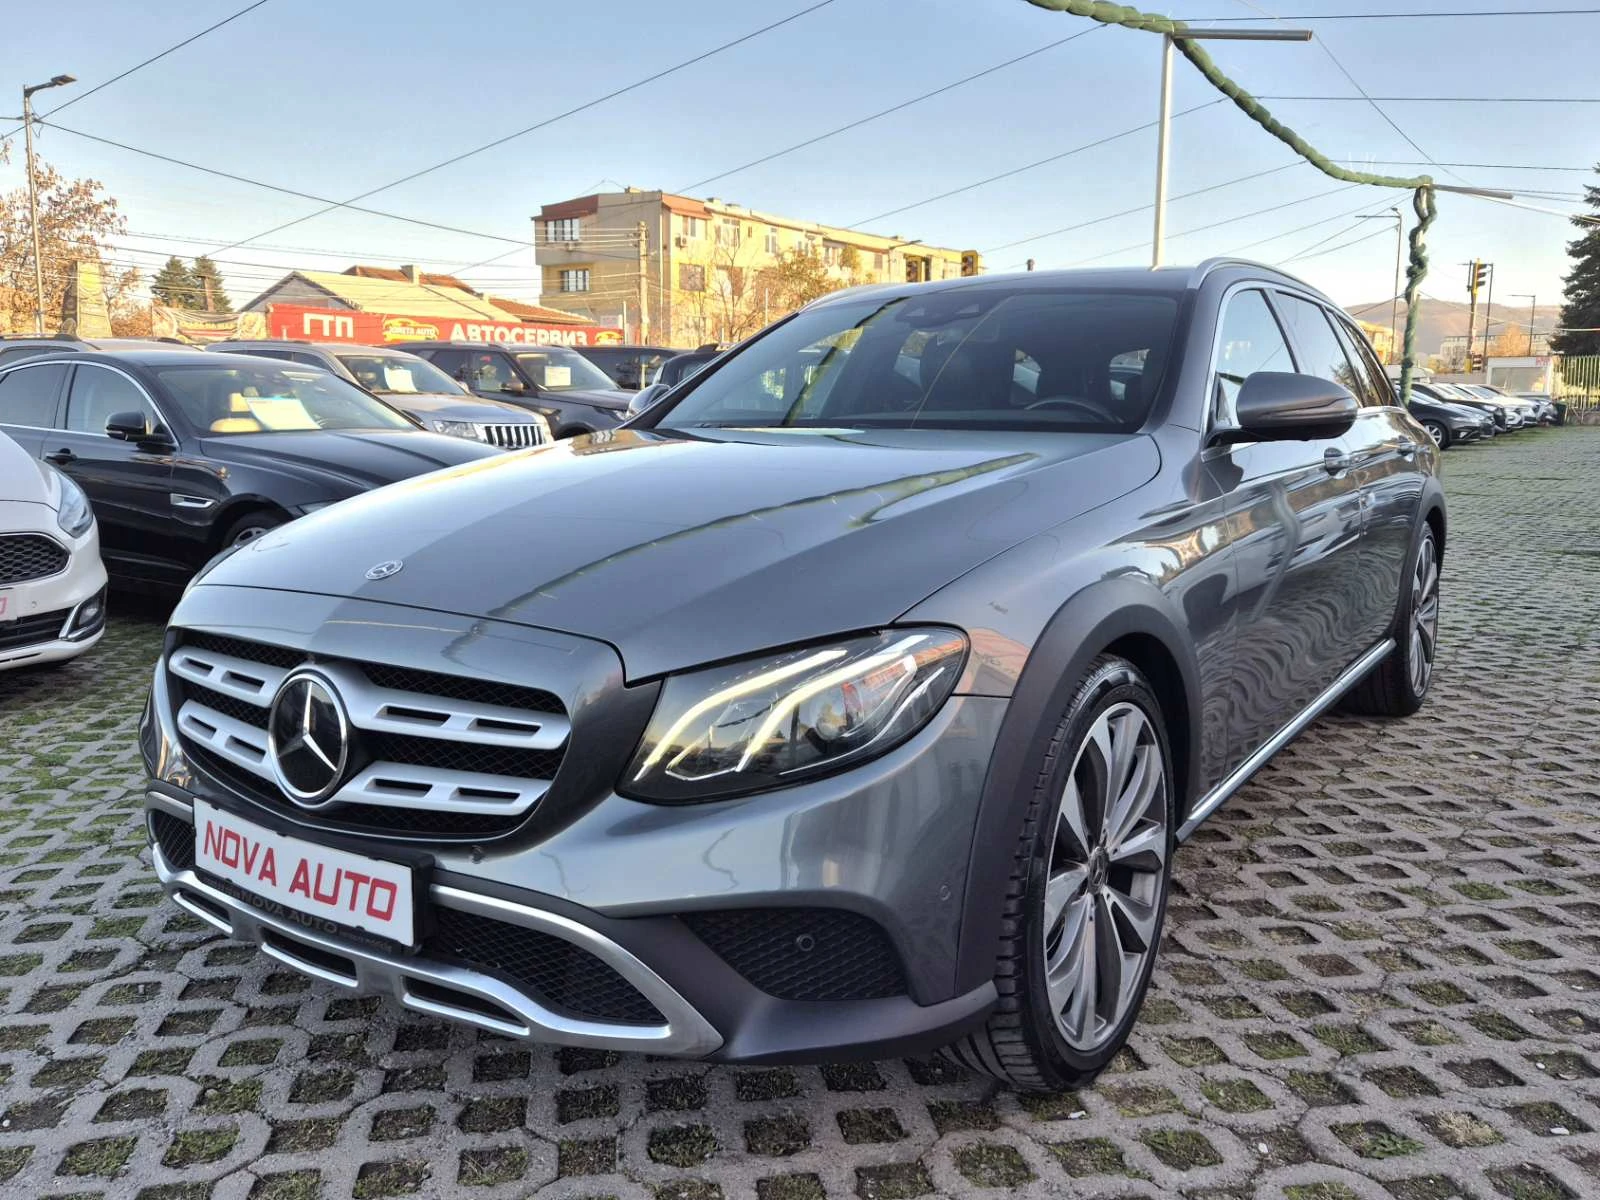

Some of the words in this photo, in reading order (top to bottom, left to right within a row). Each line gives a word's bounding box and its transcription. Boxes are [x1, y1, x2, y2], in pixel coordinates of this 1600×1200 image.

[303, 312, 354, 338] ГТП
[450, 322, 587, 345] АВТОСЕРВИЗ
[203, 820, 277, 887] NOVA
[289, 858, 398, 922] AUTO
[242, 891, 284, 916] NOVA
[288, 910, 338, 934] AUTO
